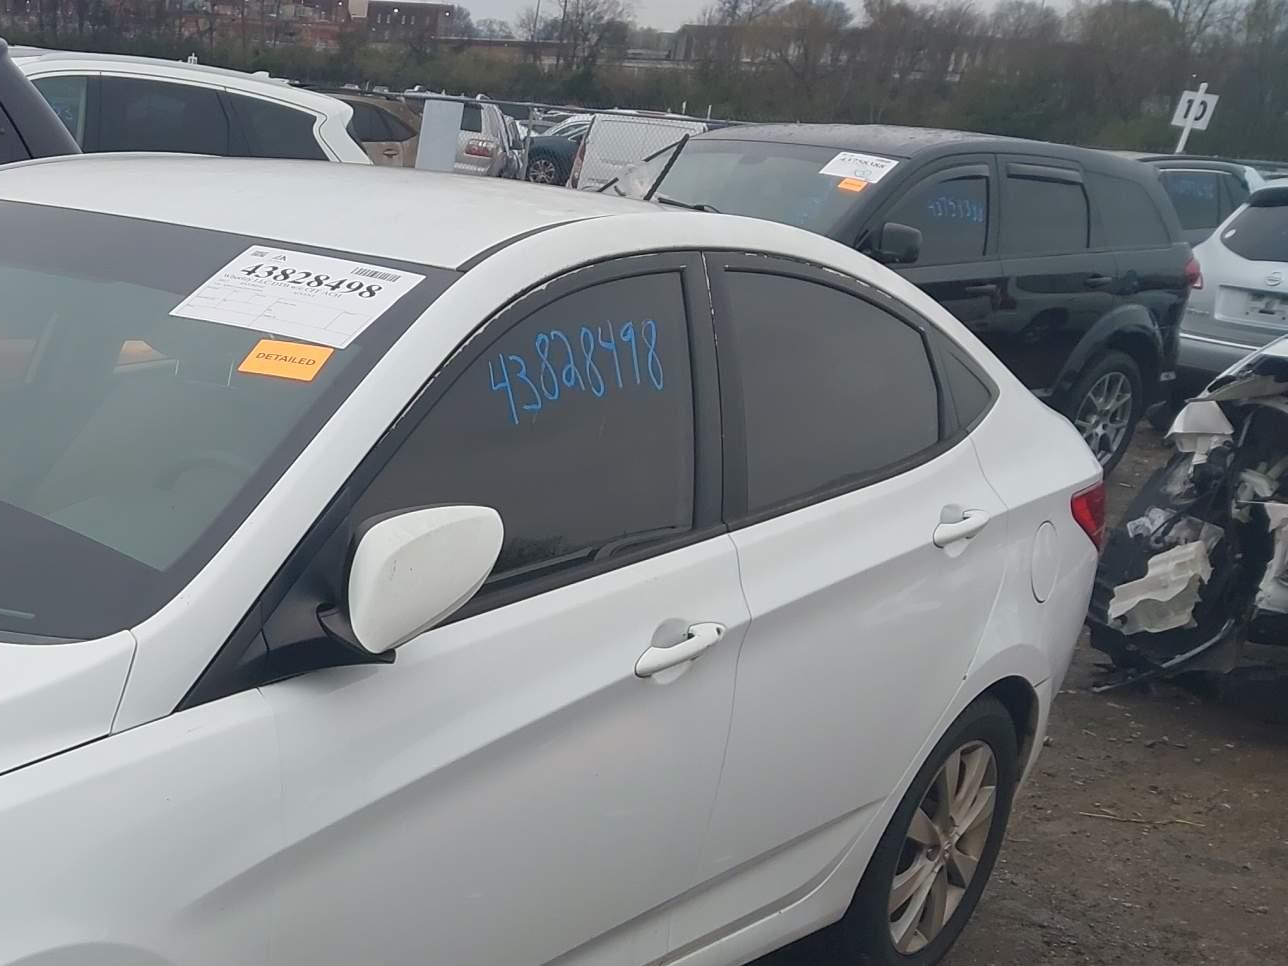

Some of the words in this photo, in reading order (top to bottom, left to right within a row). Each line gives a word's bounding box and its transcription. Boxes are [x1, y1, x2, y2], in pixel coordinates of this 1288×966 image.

[241, 263, 383, 299] 43828498
[255, 351, 316, 367] DETAILED
[488, 319, 664, 425] 43828498
